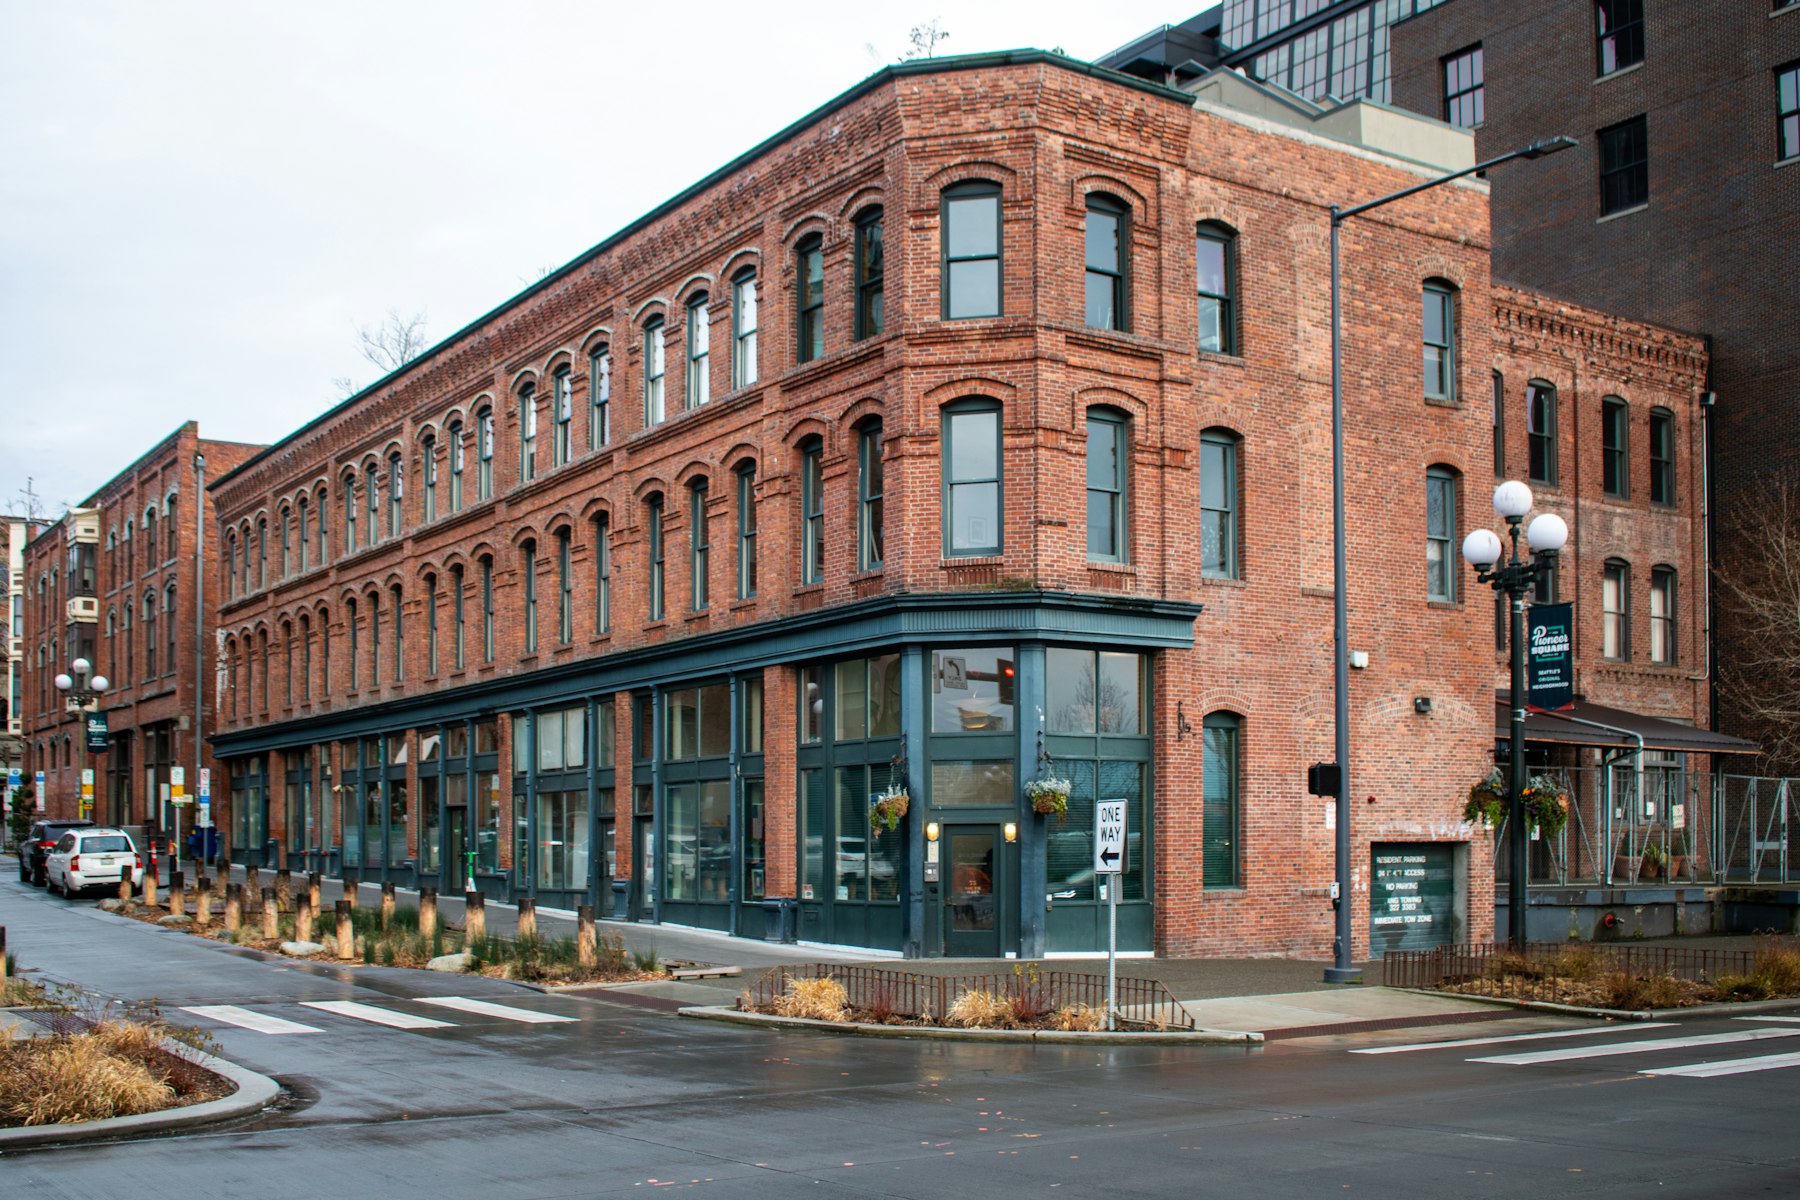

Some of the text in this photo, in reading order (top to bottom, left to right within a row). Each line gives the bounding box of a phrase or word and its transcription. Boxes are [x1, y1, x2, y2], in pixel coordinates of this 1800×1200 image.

[1531, 625, 1568, 646] Pioneer
[1531, 644, 1570, 654] SQUARE
[1102, 807, 1120, 822] ONE
[1101, 826, 1121, 842] WAY
[1403, 855, 1426, 863] PARKING
[1374, 916, 1403, 924] IMMEDIATE
[1417, 914, 1432, 922] ZONE
